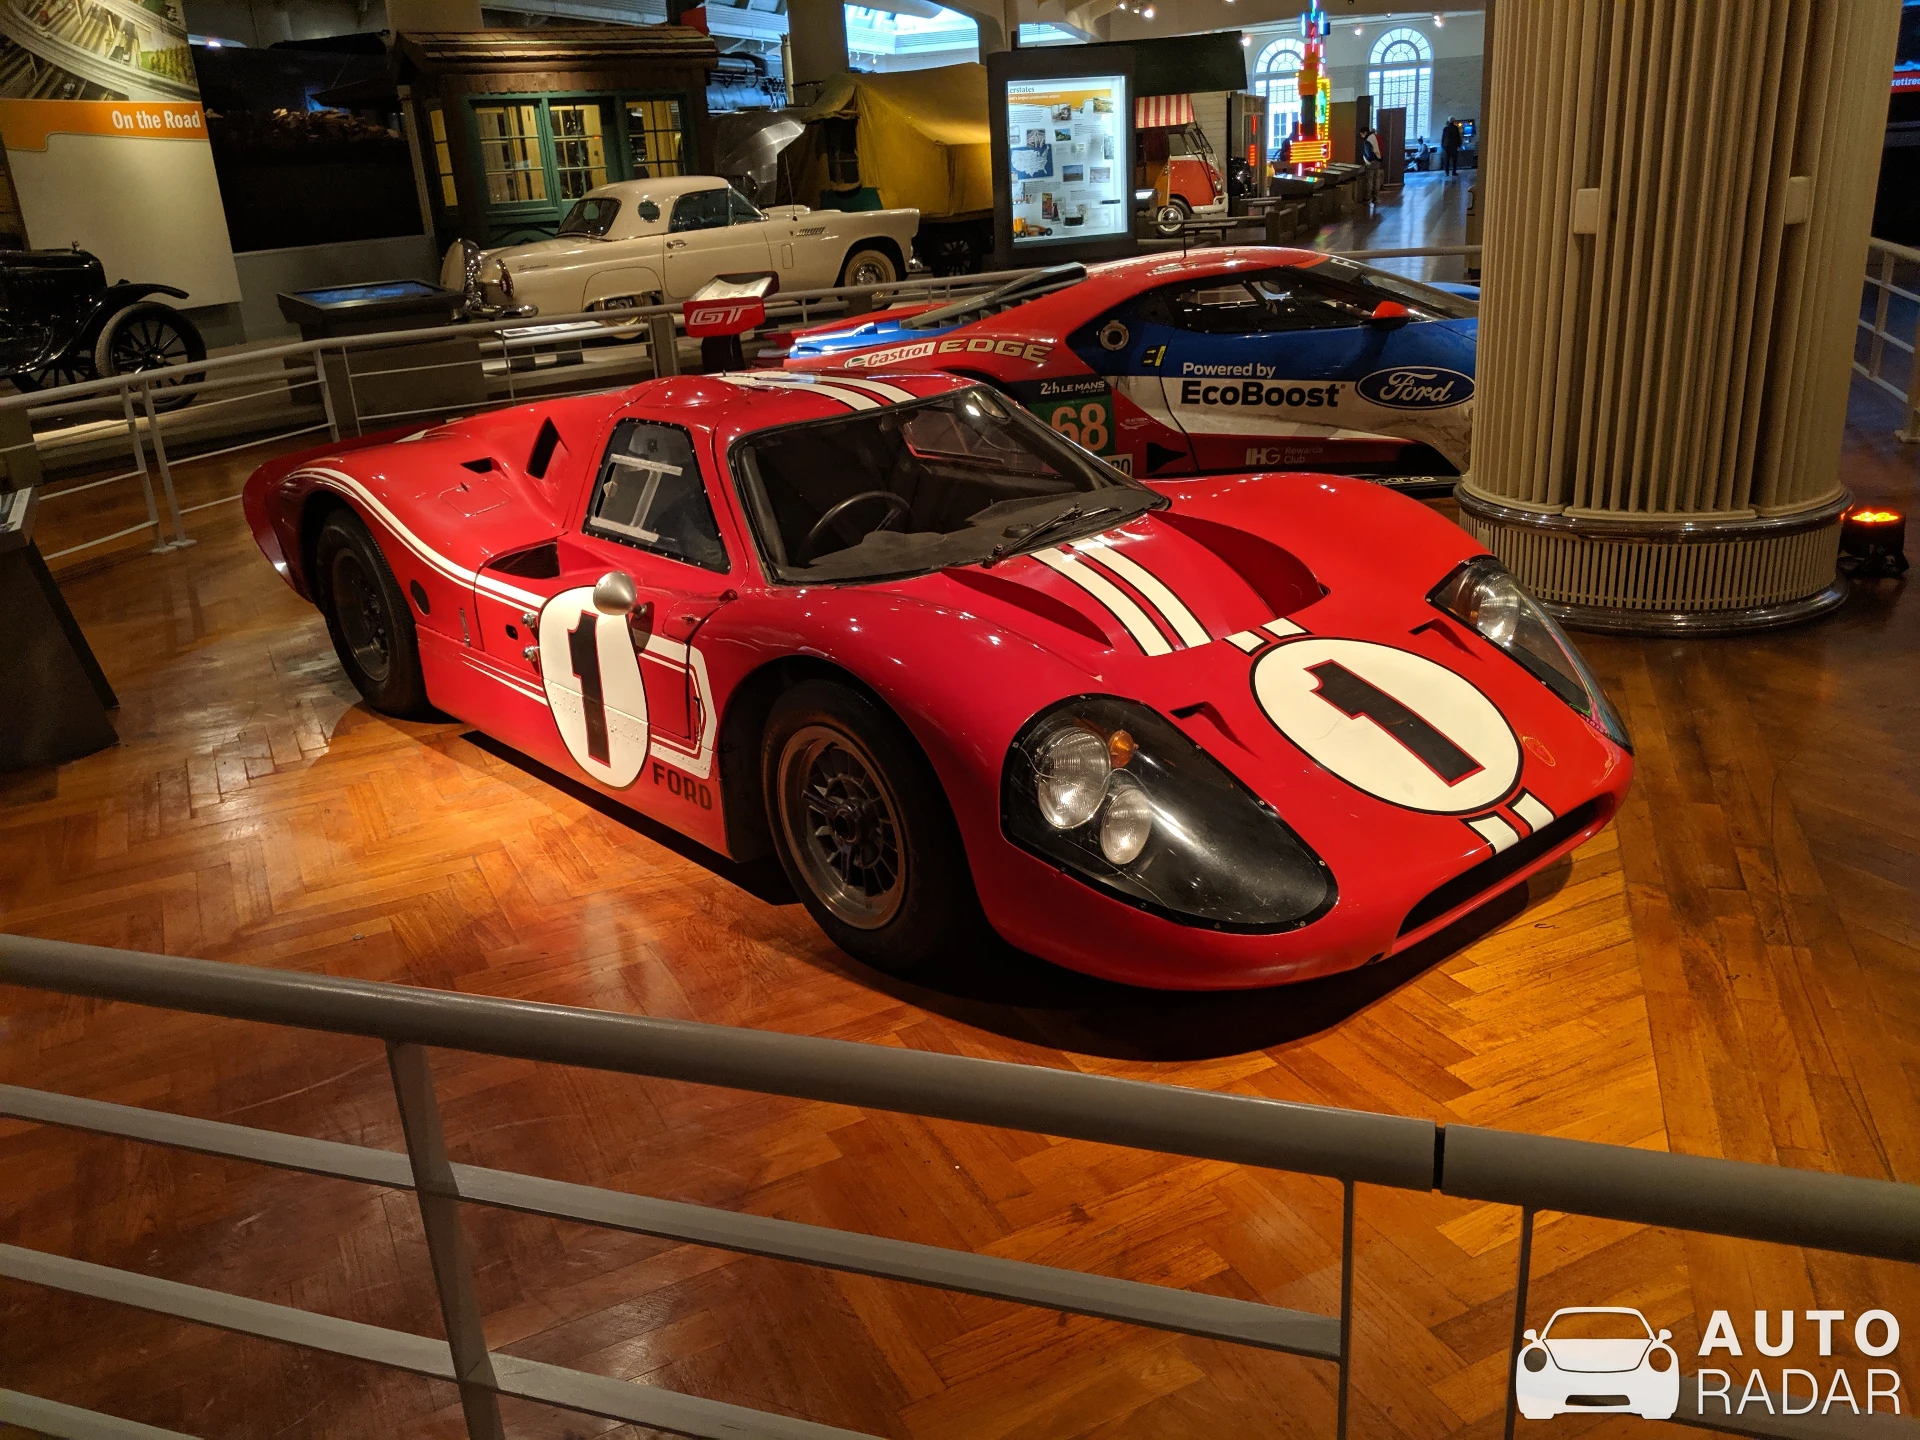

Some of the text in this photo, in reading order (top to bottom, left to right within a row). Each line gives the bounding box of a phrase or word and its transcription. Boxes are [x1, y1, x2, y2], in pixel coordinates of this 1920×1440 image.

[112, 110, 201, 129] On the Road
[689, 304, 761, 325] GT
[868, 339, 1053, 367] Castrol EDGE
[1182, 363, 1276, 378] Powered by
[1061, 384, 1074, 392] LE
[1075, 381, 1105, 391] MANS
[1379, 371, 1455, 401] Ford
[1051, 403, 1108, 452] 68
[1245, 446, 1324, 466] IHG Rewards
[1284, 455, 1306, 465] Club
[567, 609, 611, 769] 1
[1303, 659, 1486, 788] 1
[653, 762, 712, 811] FORD
